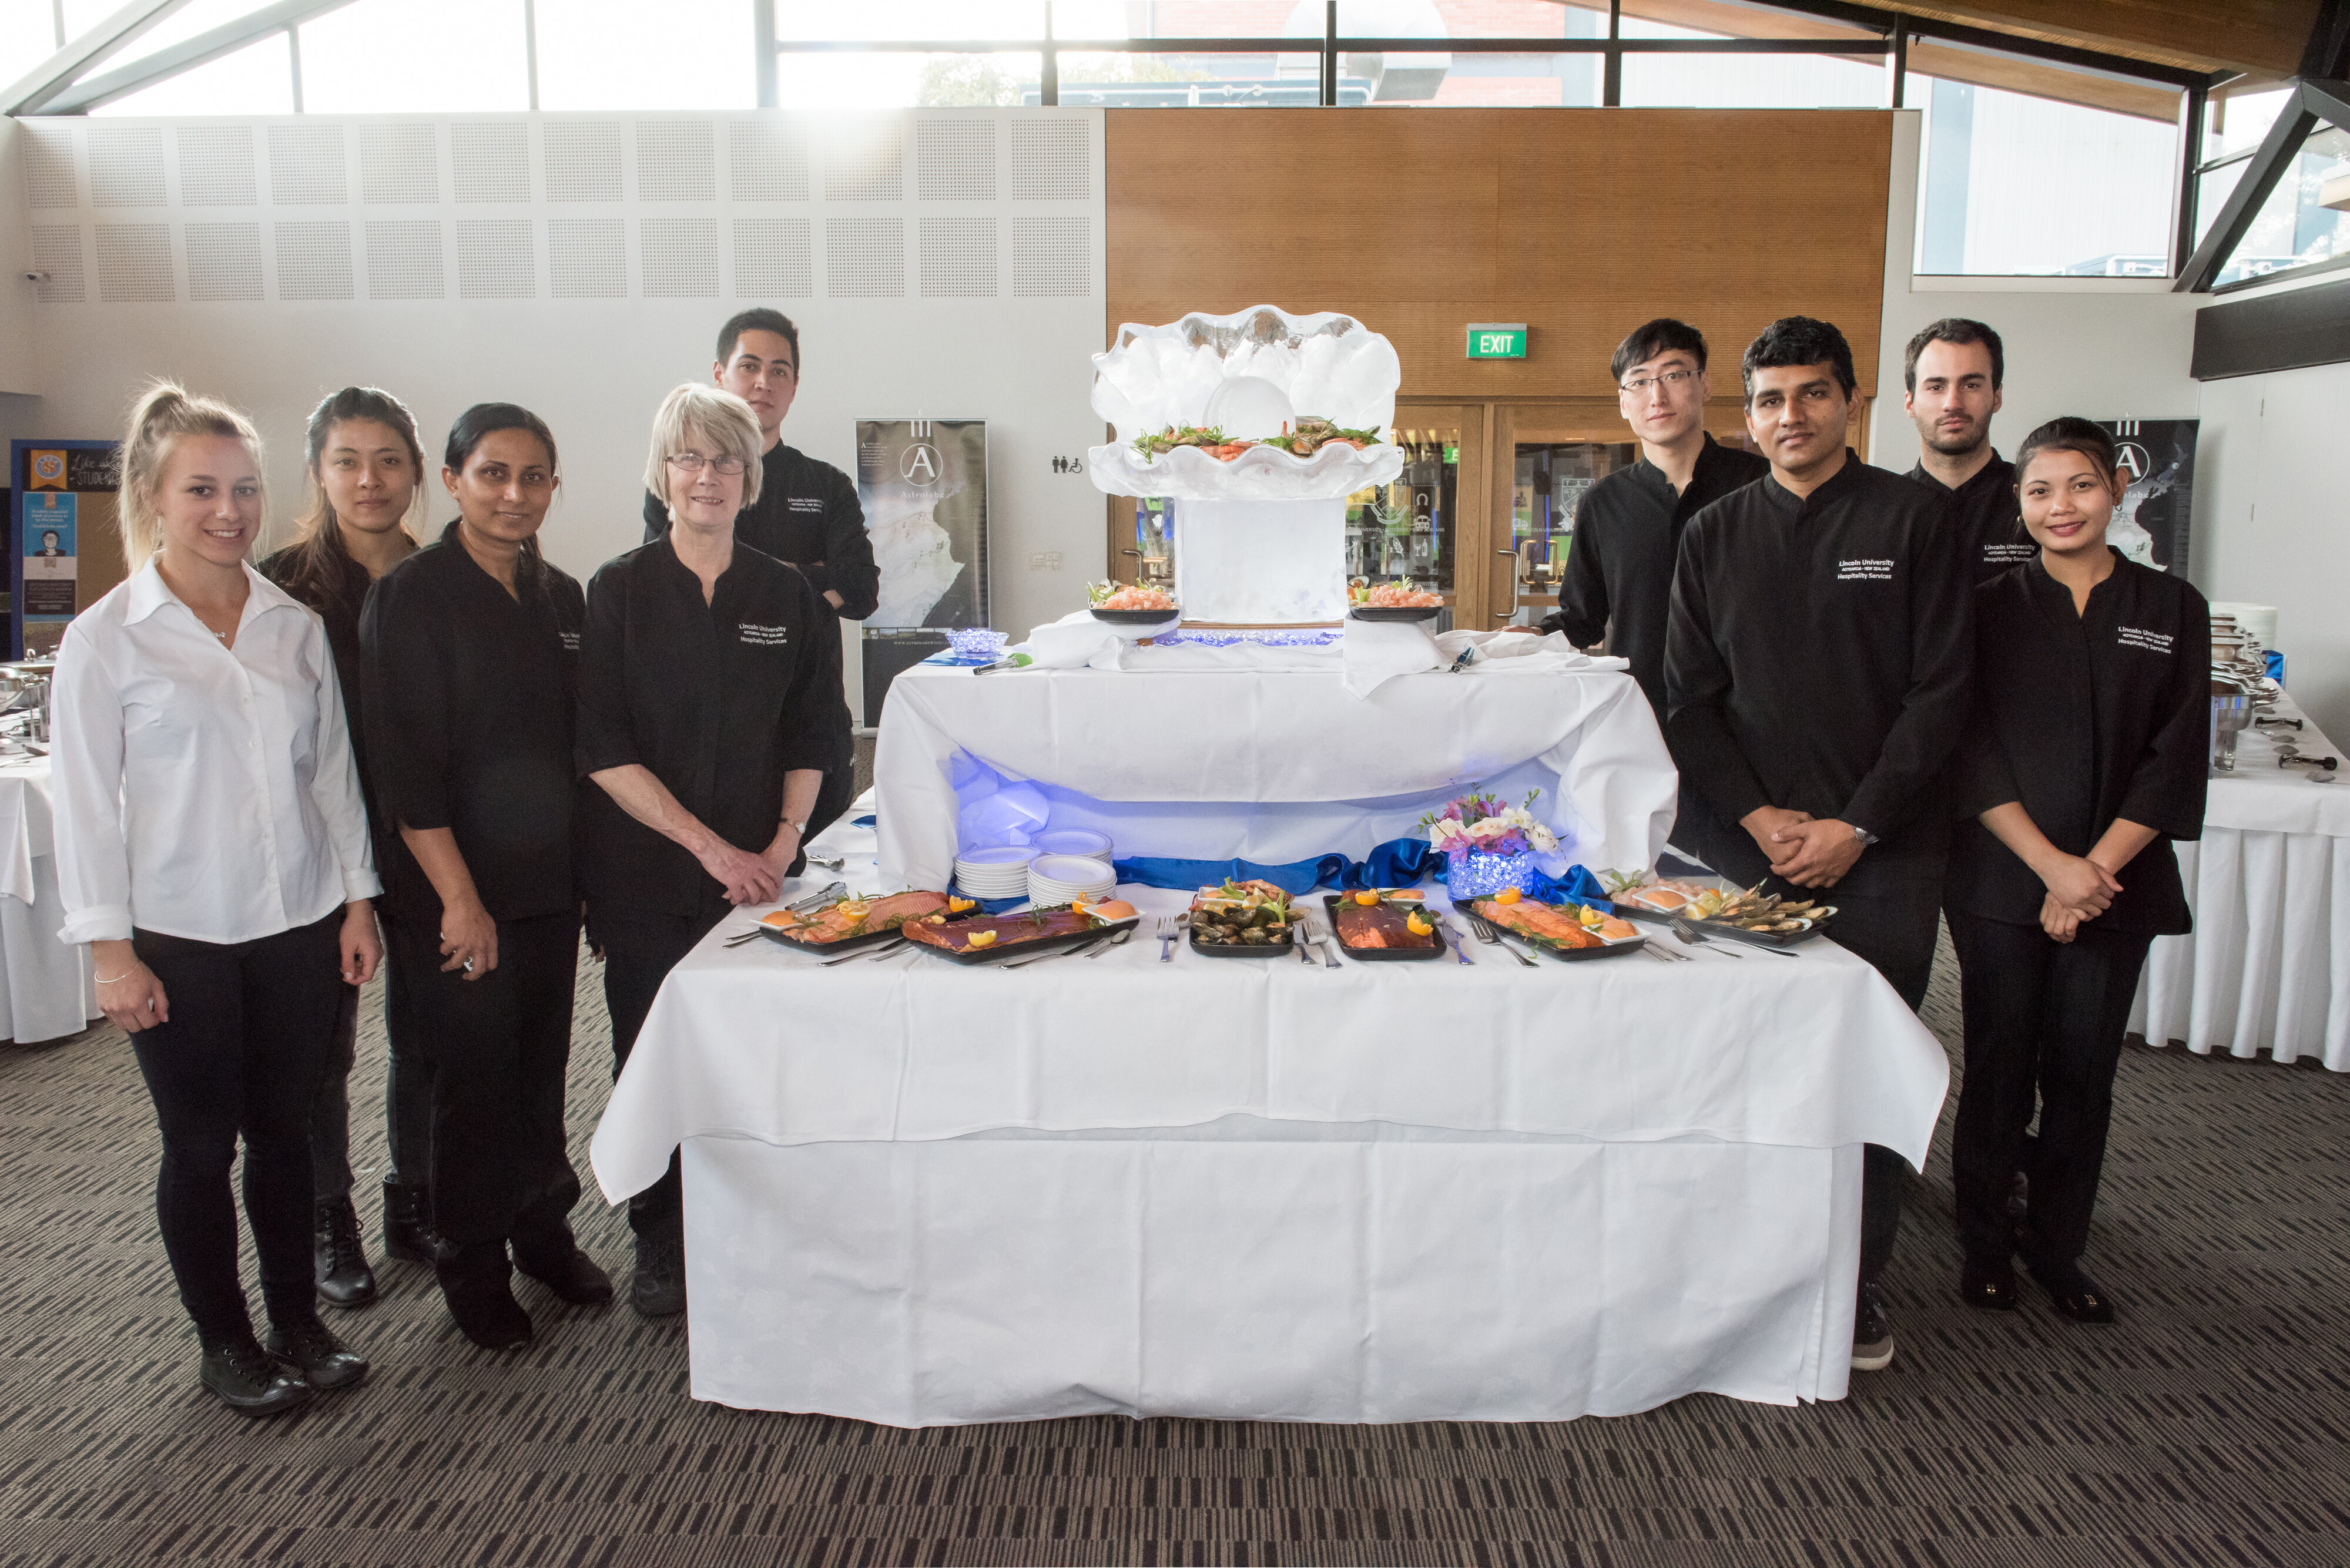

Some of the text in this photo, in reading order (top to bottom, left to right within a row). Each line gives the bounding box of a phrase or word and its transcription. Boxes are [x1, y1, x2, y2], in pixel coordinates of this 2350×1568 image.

[1480, 335, 1514, 353] EXIT
[904, 446, 936, 478] A
[740, 636, 765, 645] Hospitality
[2118, 626, 2173, 642] Lincoln University
[2118, 638, 2171, 653] Hospitality Services
